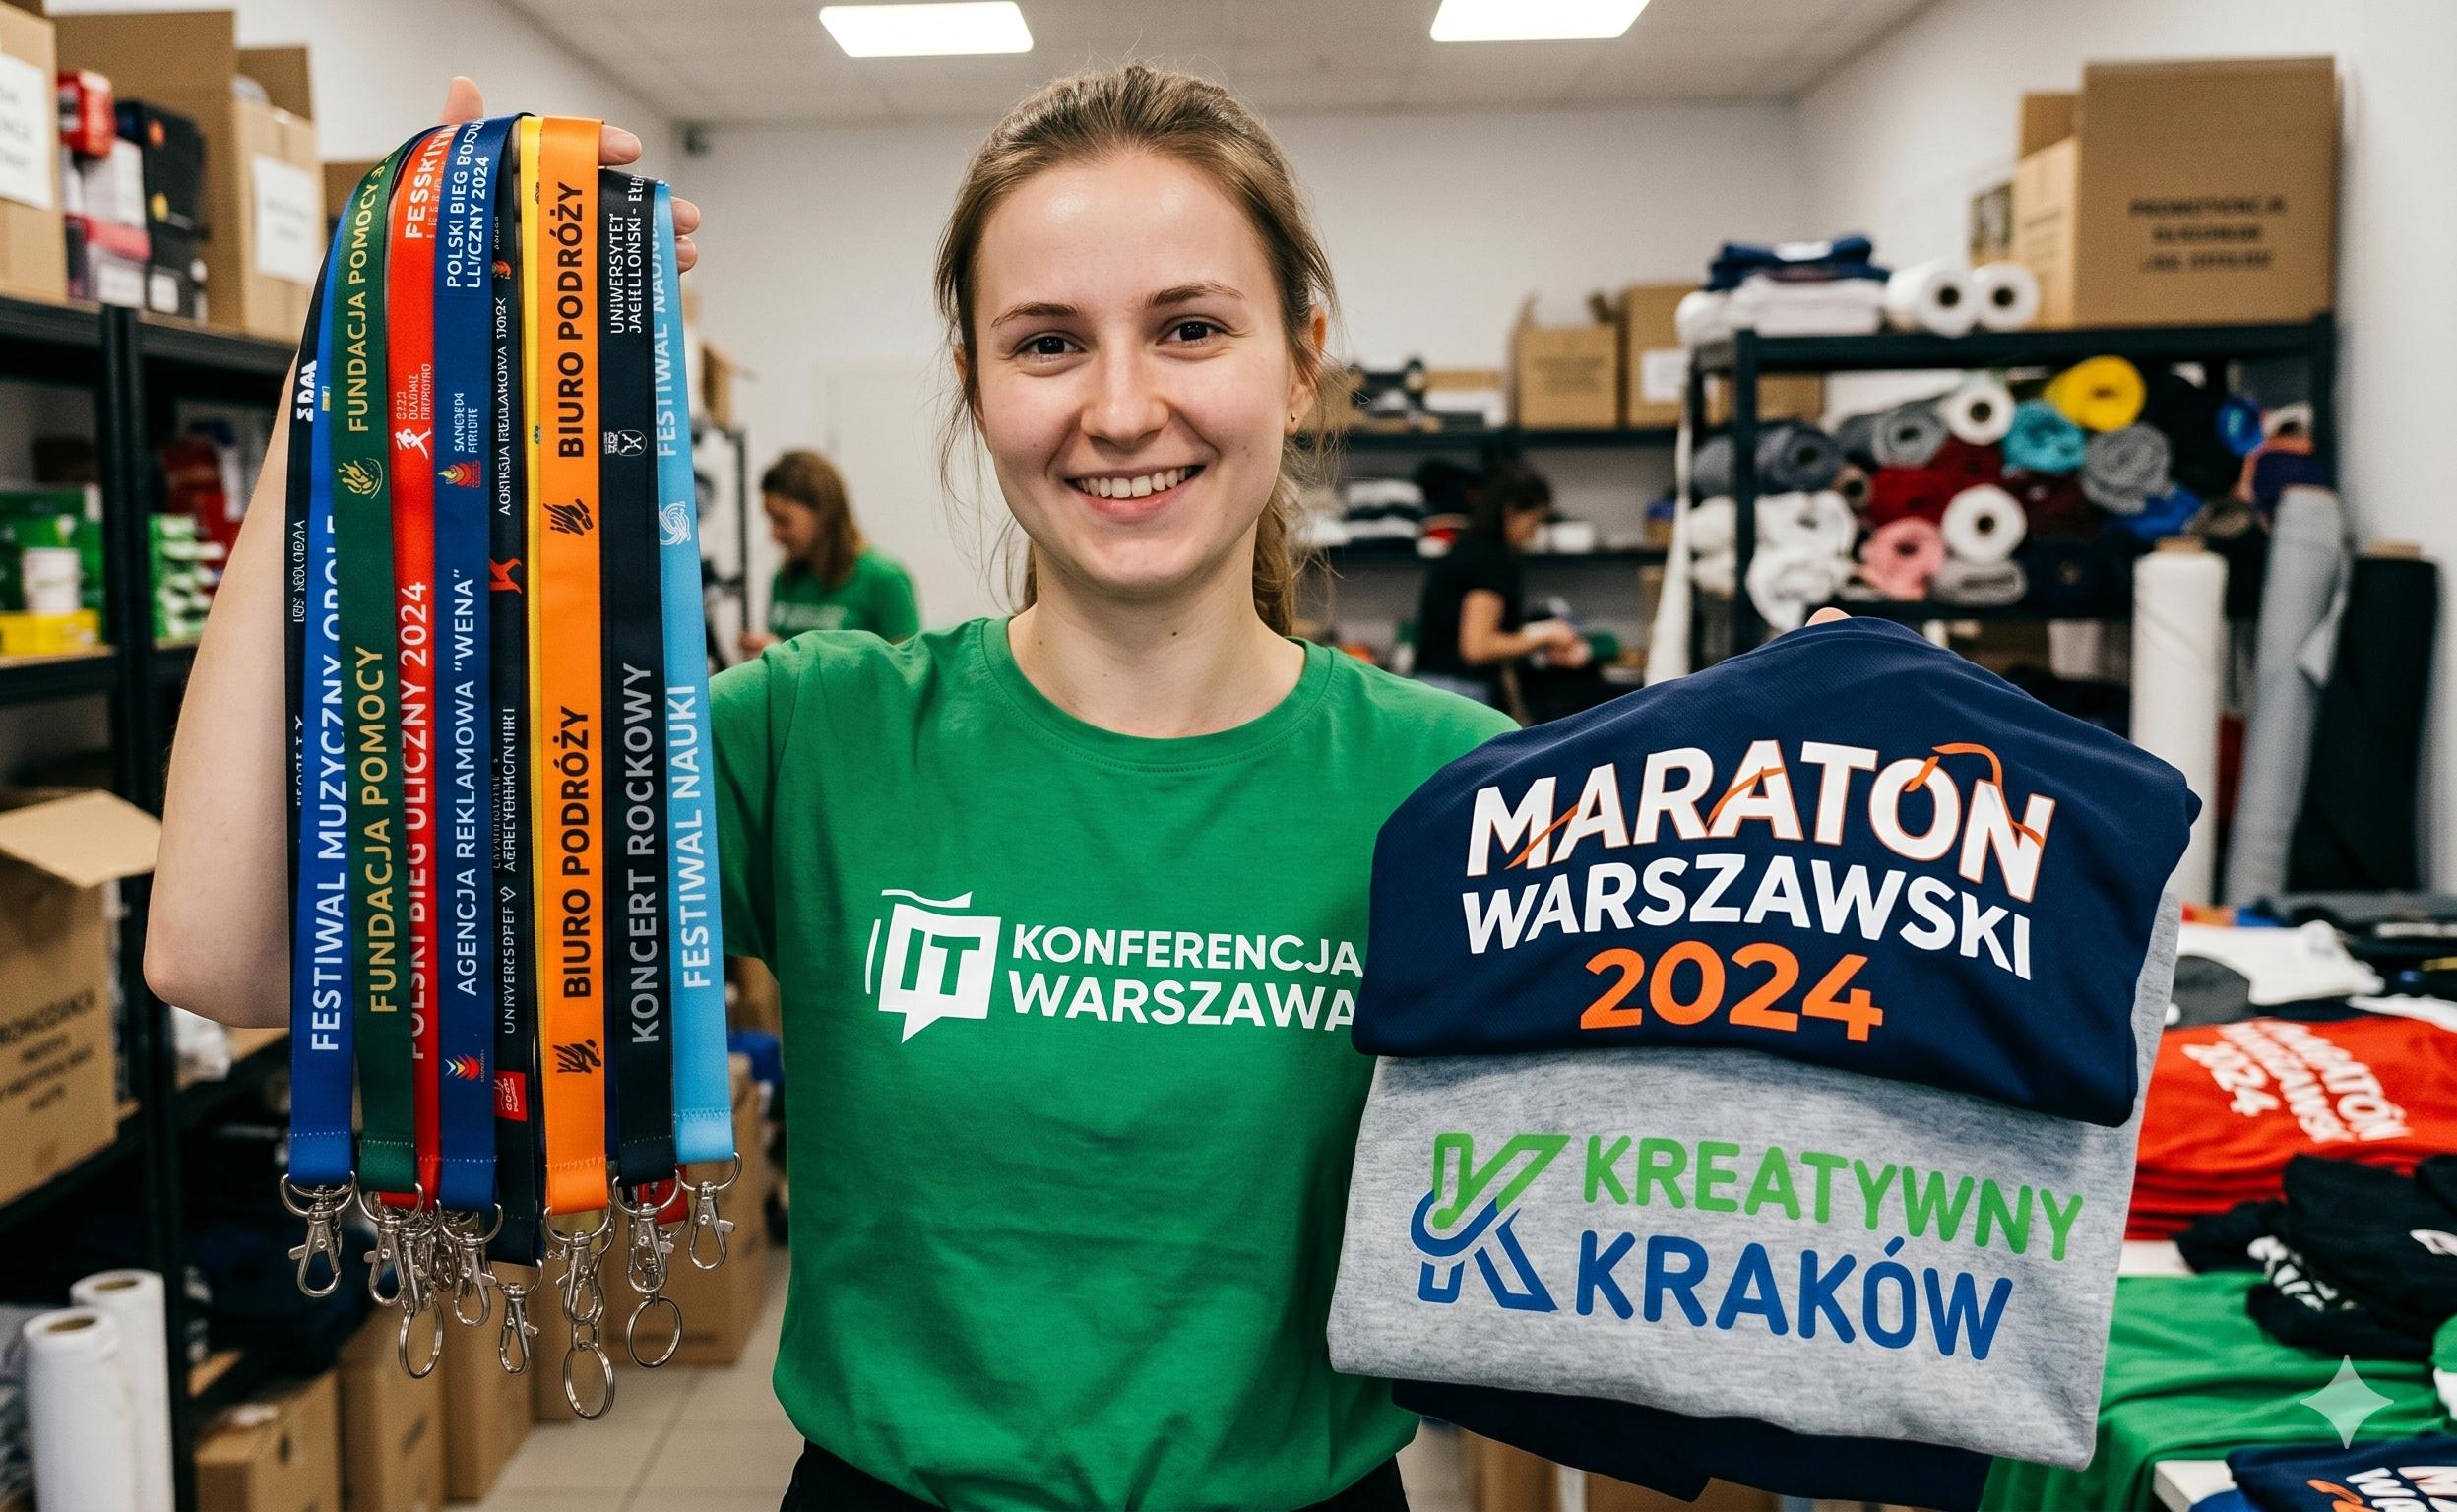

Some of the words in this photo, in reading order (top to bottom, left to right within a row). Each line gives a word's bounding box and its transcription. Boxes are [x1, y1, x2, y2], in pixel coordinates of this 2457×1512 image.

[348, 183, 380, 284] POMOCY
[449, 171, 469, 214] BIEG
[471, 156, 490, 200] 2024
[446, 220, 465, 288] POLSKI
[550, 181, 584, 341] PODRÓŻY
[346, 291, 369, 433] FUNDACJA
[558, 351, 584, 458] BIURO
[652, 324, 676, 457] FESTIWAL
[400, 582, 427, 667] 2024
[317, 655, 347, 859] MUZYCZNY
[355, 646, 389, 805] POMOCY
[401, 680, 427, 830] ULICZNY
[455, 681, 476, 858] REKLAMOWA
[622, 663, 656, 855] ROCKOWY
[666, 685, 700, 798] NAUKI
[553, 706, 590, 876] PODRÓŻY
[364, 818, 397, 1012] FUNDACJA
[407, 843, 426, 923] BIEG
[457, 869, 477, 995] AGENCJA
[563, 889, 591, 998] BIURO
[675, 810, 711, 987] FESTIWAL
[1462, 853, 2032, 980] WARSZAWSKI
[311, 873, 346, 1051] FESTIWAL
[627, 870, 659, 1042] KONCERT
[1008, 971, 1355, 1032] WARSZAWA
[1014, 924, 1363, 976] KONFERENCJA
[1579, 940, 1884, 1042] 2024
[1583, 1135, 2083, 1262] KREATYWNY
[1575, 1229, 2013, 1360] KRAKÓW
